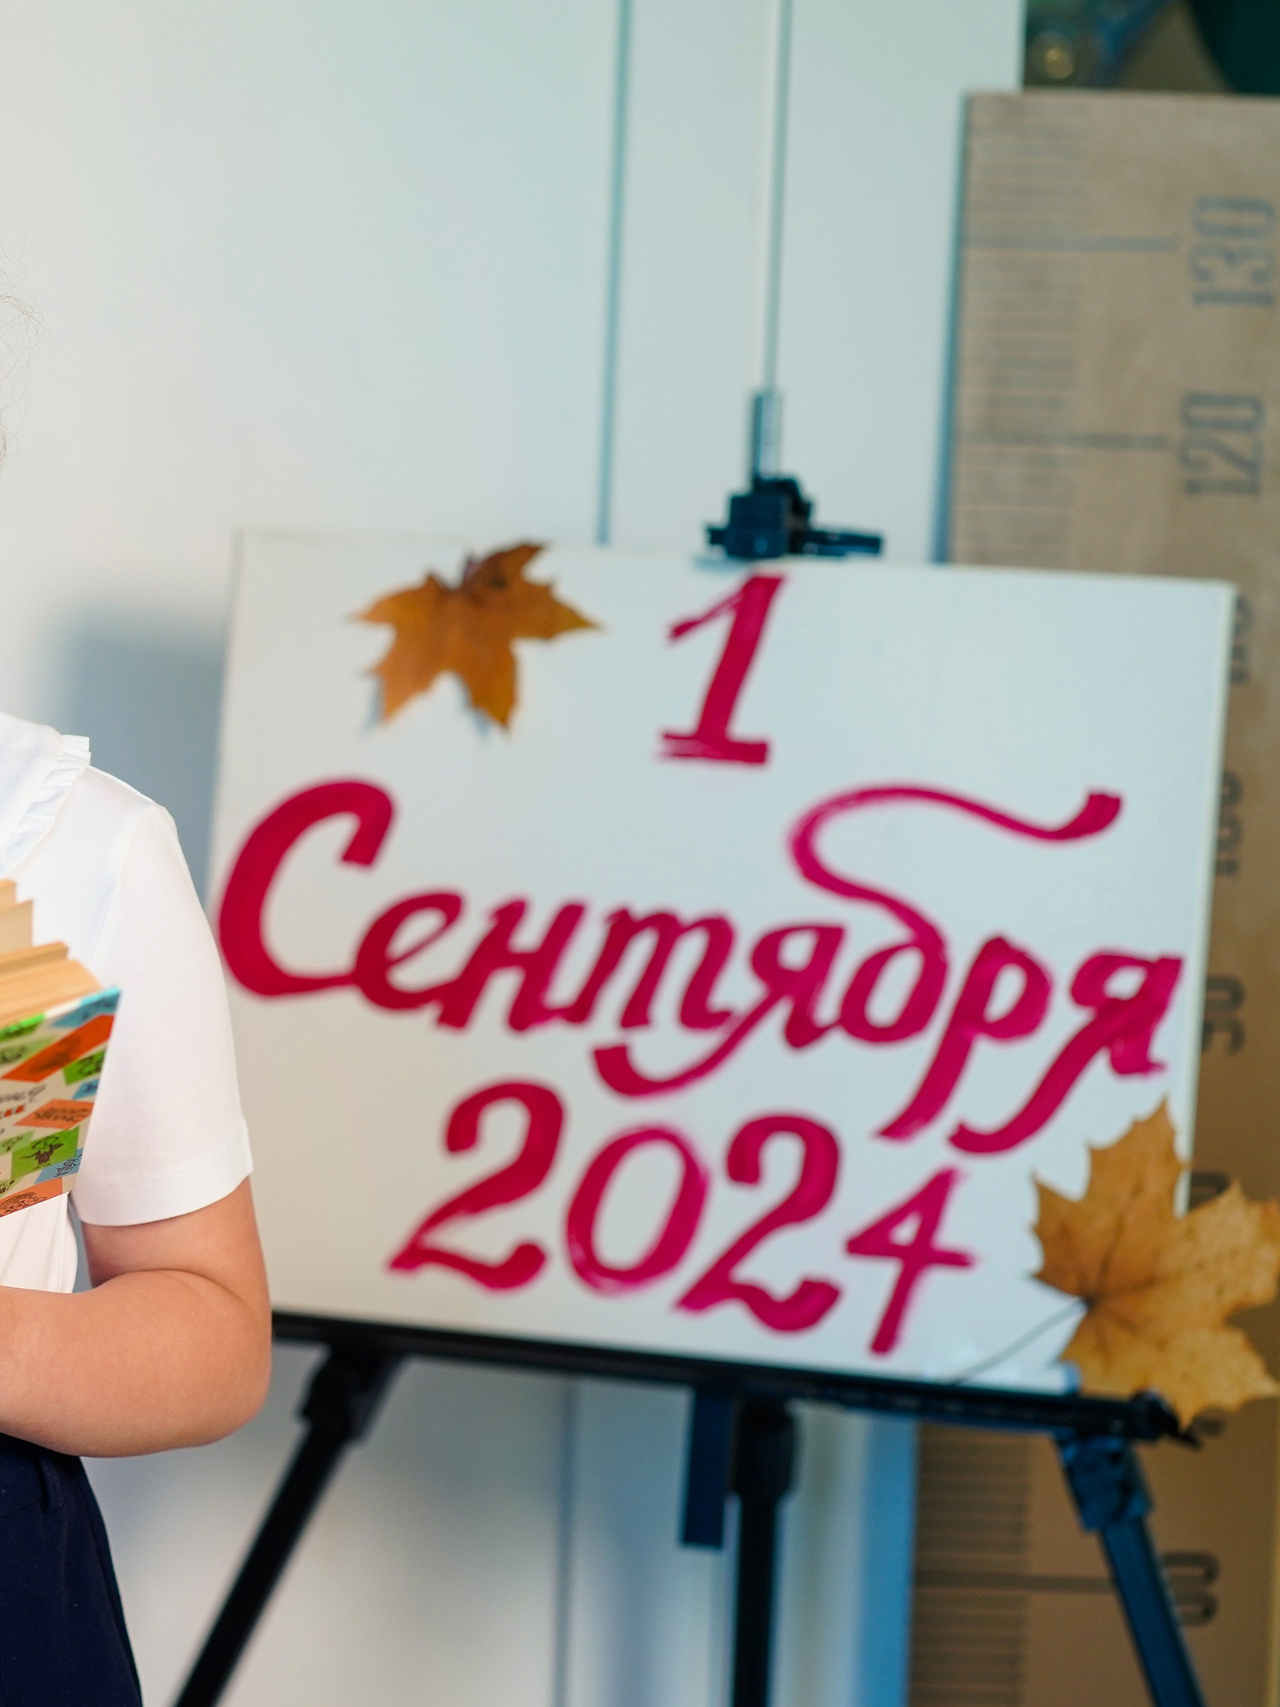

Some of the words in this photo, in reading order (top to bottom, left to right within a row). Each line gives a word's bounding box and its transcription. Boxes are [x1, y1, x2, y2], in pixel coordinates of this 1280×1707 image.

[1190, 196, 1276, 307] 130
[1177, 391, 1265, 496] 120
[659, 574, 784, 766] 1
[217, 780, 1183, 1155] Сентября
[388, 1081, 975, 1356] 2024
